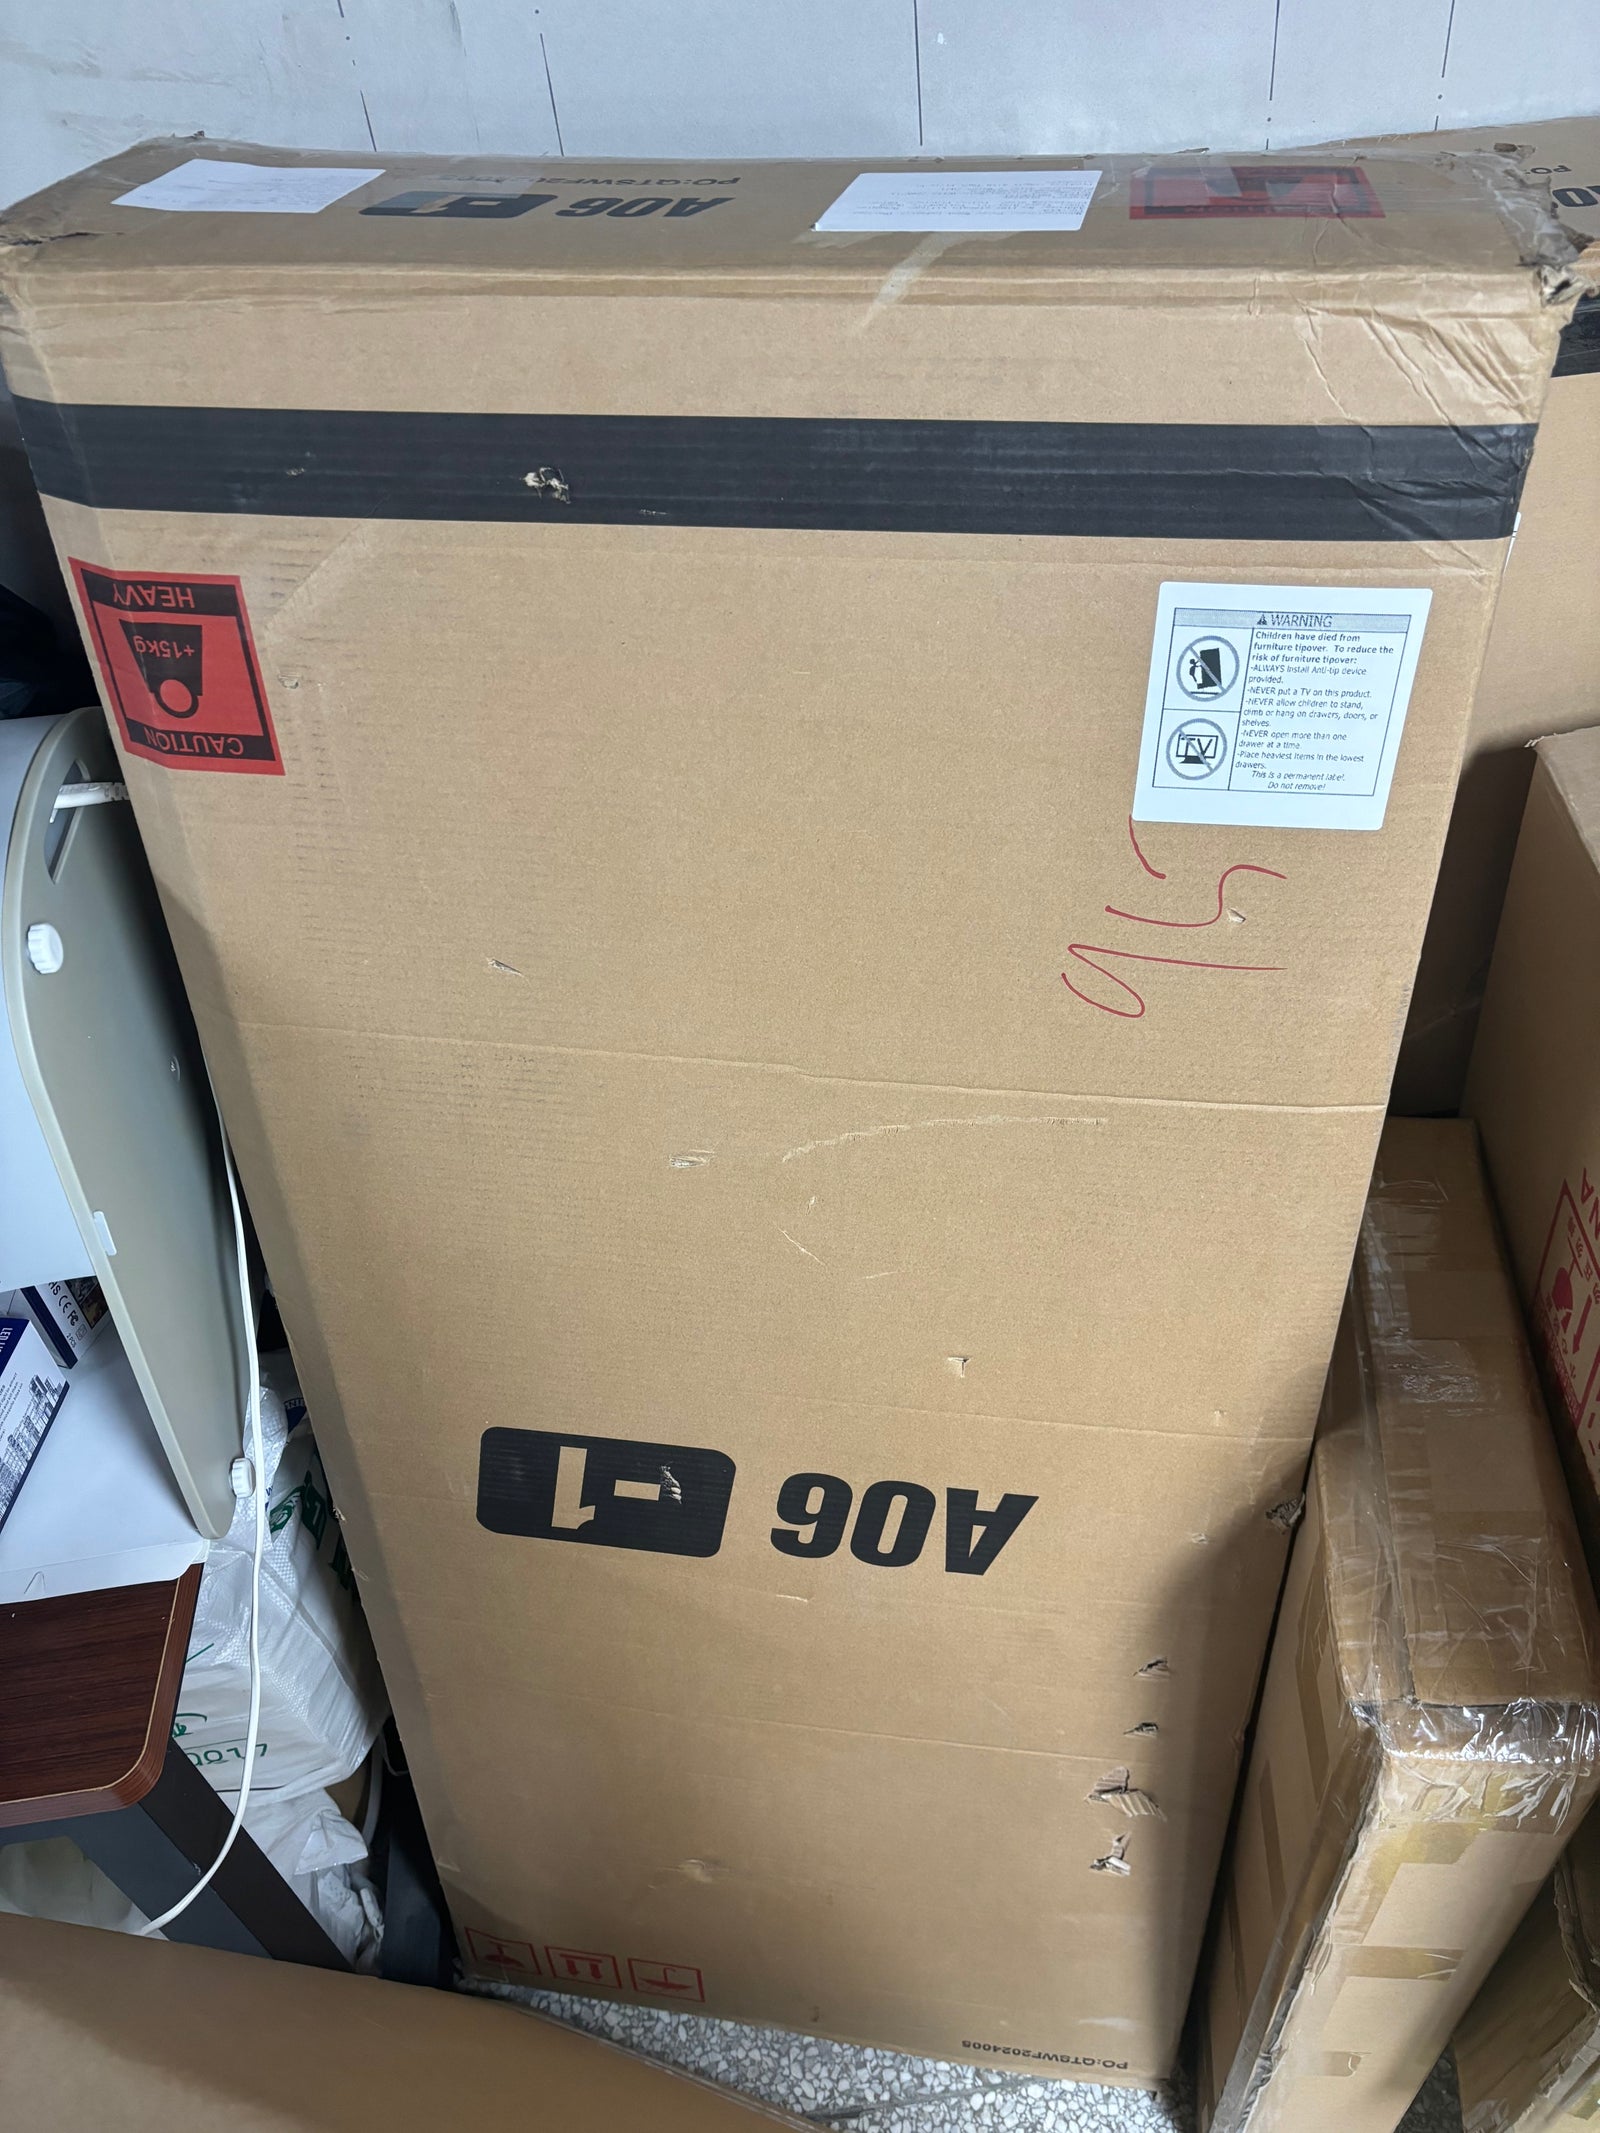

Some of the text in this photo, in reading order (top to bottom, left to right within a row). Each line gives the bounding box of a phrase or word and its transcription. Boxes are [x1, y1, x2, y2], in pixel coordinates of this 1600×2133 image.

[555, 196, 737, 218] A06
[113, 583, 196, 609] HEAVY
[1271, 614, 1333, 628] WARNING
[1255, 631, 1361, 642] Children have died from
[133, 635, 195, 659] +15kg
[1253, 642, 1394, 654] furniture tipover. To reduce the
[1252, 653, 1357, 665] risk of furniture tipover:
[1311, 666, 1340, 675] Anti-tip
[1341, 667, 1367, 675] device
[1248, 675, 1284, 684] provided.
[1277, 687, 1291, 696] put
[1300, 688, 1311, 696] TV
[1324, 688, 1339, 697] this
[1341, 689, 1372, 698] product.
[1276, 698, 1296, 706] allow
[1297, 698, 1328, 707] children
[1330, 699, 1338, 708] to
[1340, 700, 1363, 710] stand,
[1243, 708, 1263, 716] climb
[1275, 709, 1295, 719] hang
[1297, 710, 1307, 718] on
[1308, 711, 1341, 720] drawers,
[1343, 711, 1367, 721] doors,
[144, 727, 245, 756] CAUTION
[1271, 731, 1290, 740] open
[1292, 731, 1311, 739] more
[1313, 731, 1330, 740] than
[1238, 740, 1265, 748] drawer
[1261, 751, 1292, 760] heaviest
[1325, 753, 1338, 762] the
[1340, 754, 1364, 762] lowest
[1251, 770, 1267, 779] This
[1283, 772, 1324, 781] permanent
[1267, 781, 1279, 789] Do
[1280, 781, 1294, 790] not
[770, 1472, 1040, 1576] A06
